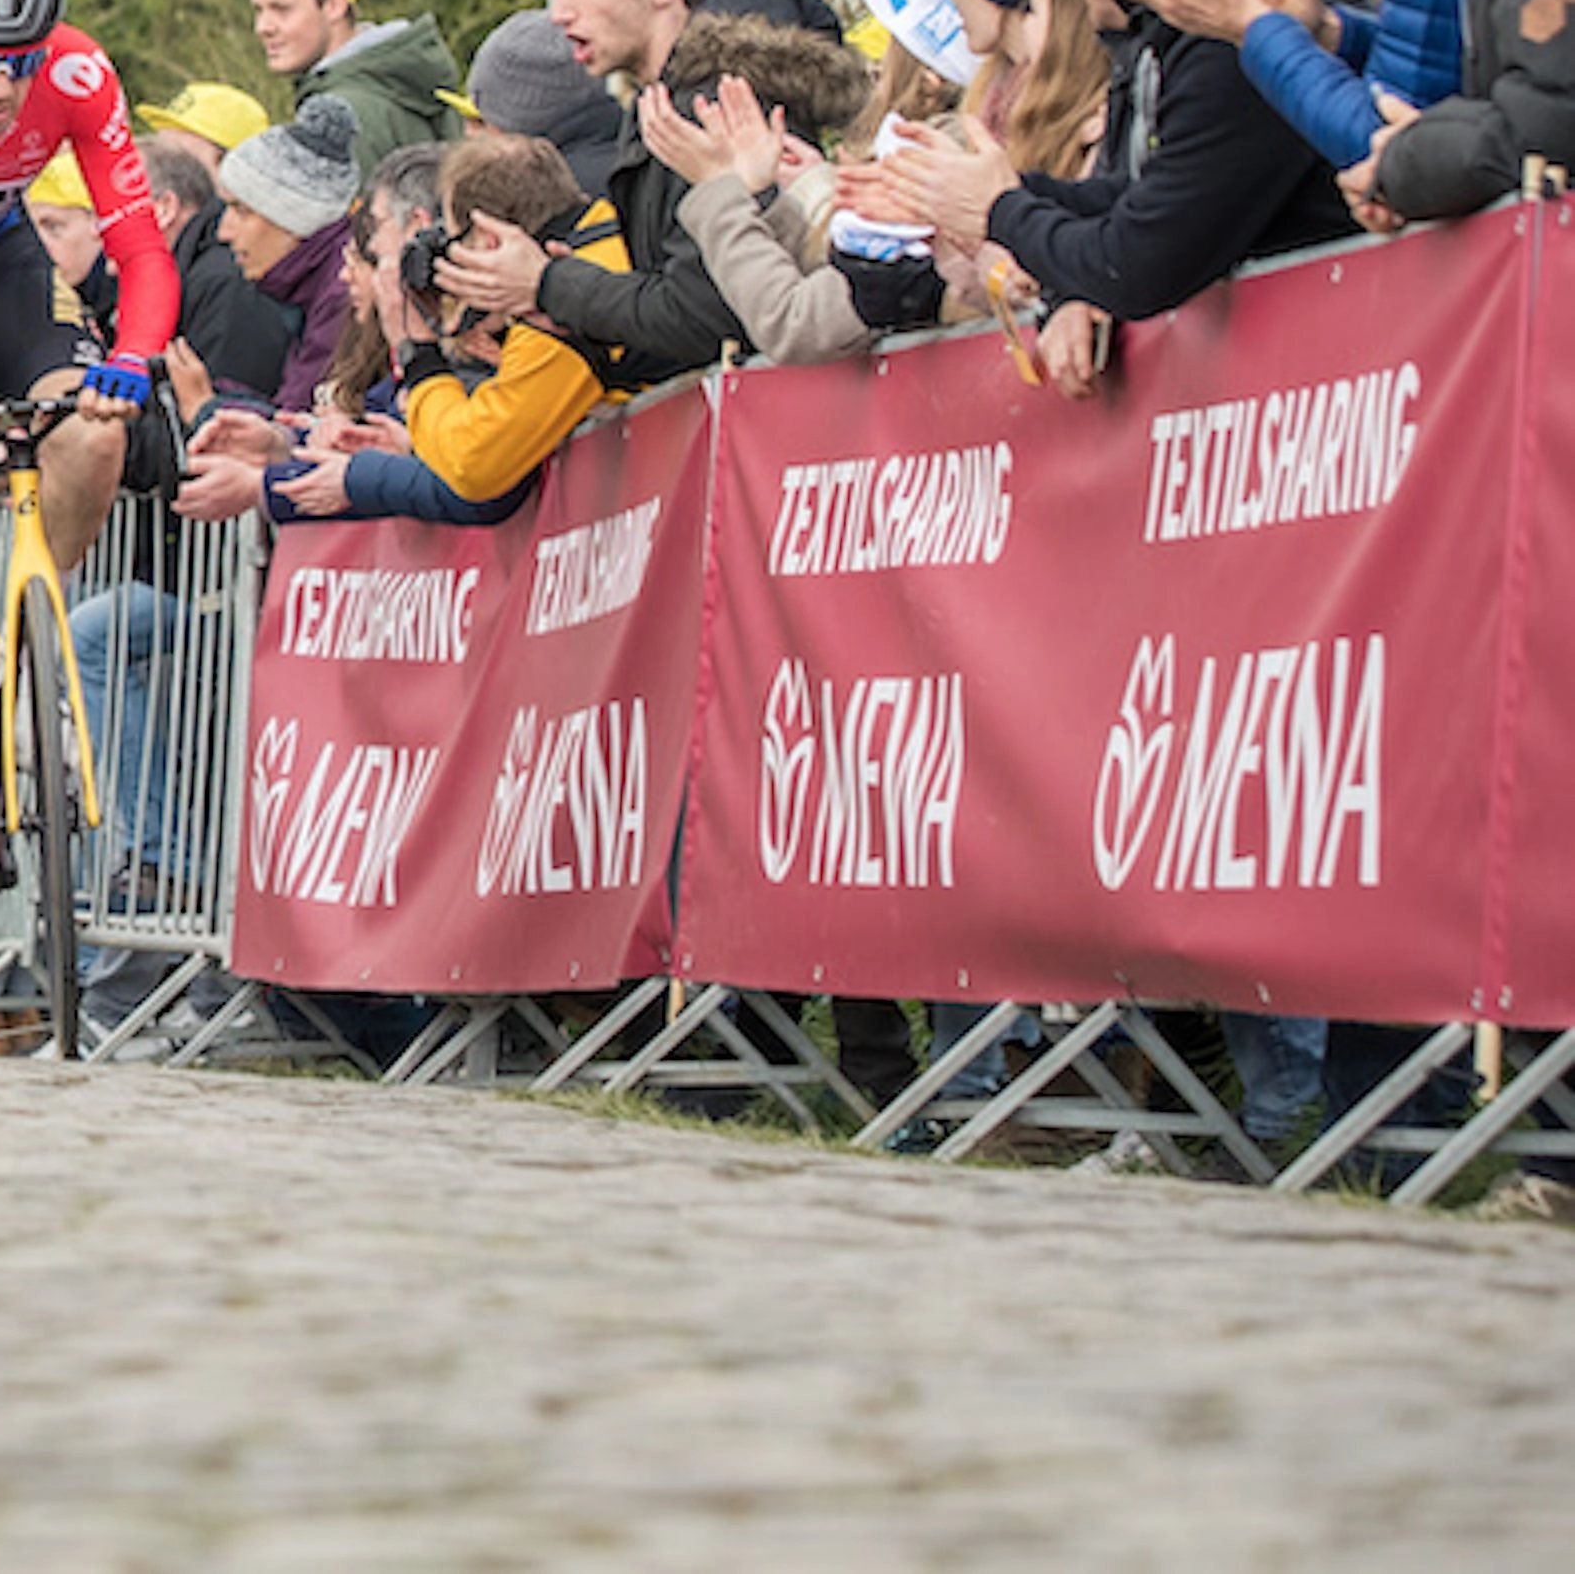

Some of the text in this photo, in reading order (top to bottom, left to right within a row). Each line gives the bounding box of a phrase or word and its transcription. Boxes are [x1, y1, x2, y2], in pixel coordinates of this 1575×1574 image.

[769, 441, 1012, 576] TEXTILSHARING
[1145, 361, 1421, 543] TEXTILSHARING
[501, 696, 647, 896] MEWA
[809, 673, 966, 888] MEWA
[1154, 633, 1385, 891] MEWA
